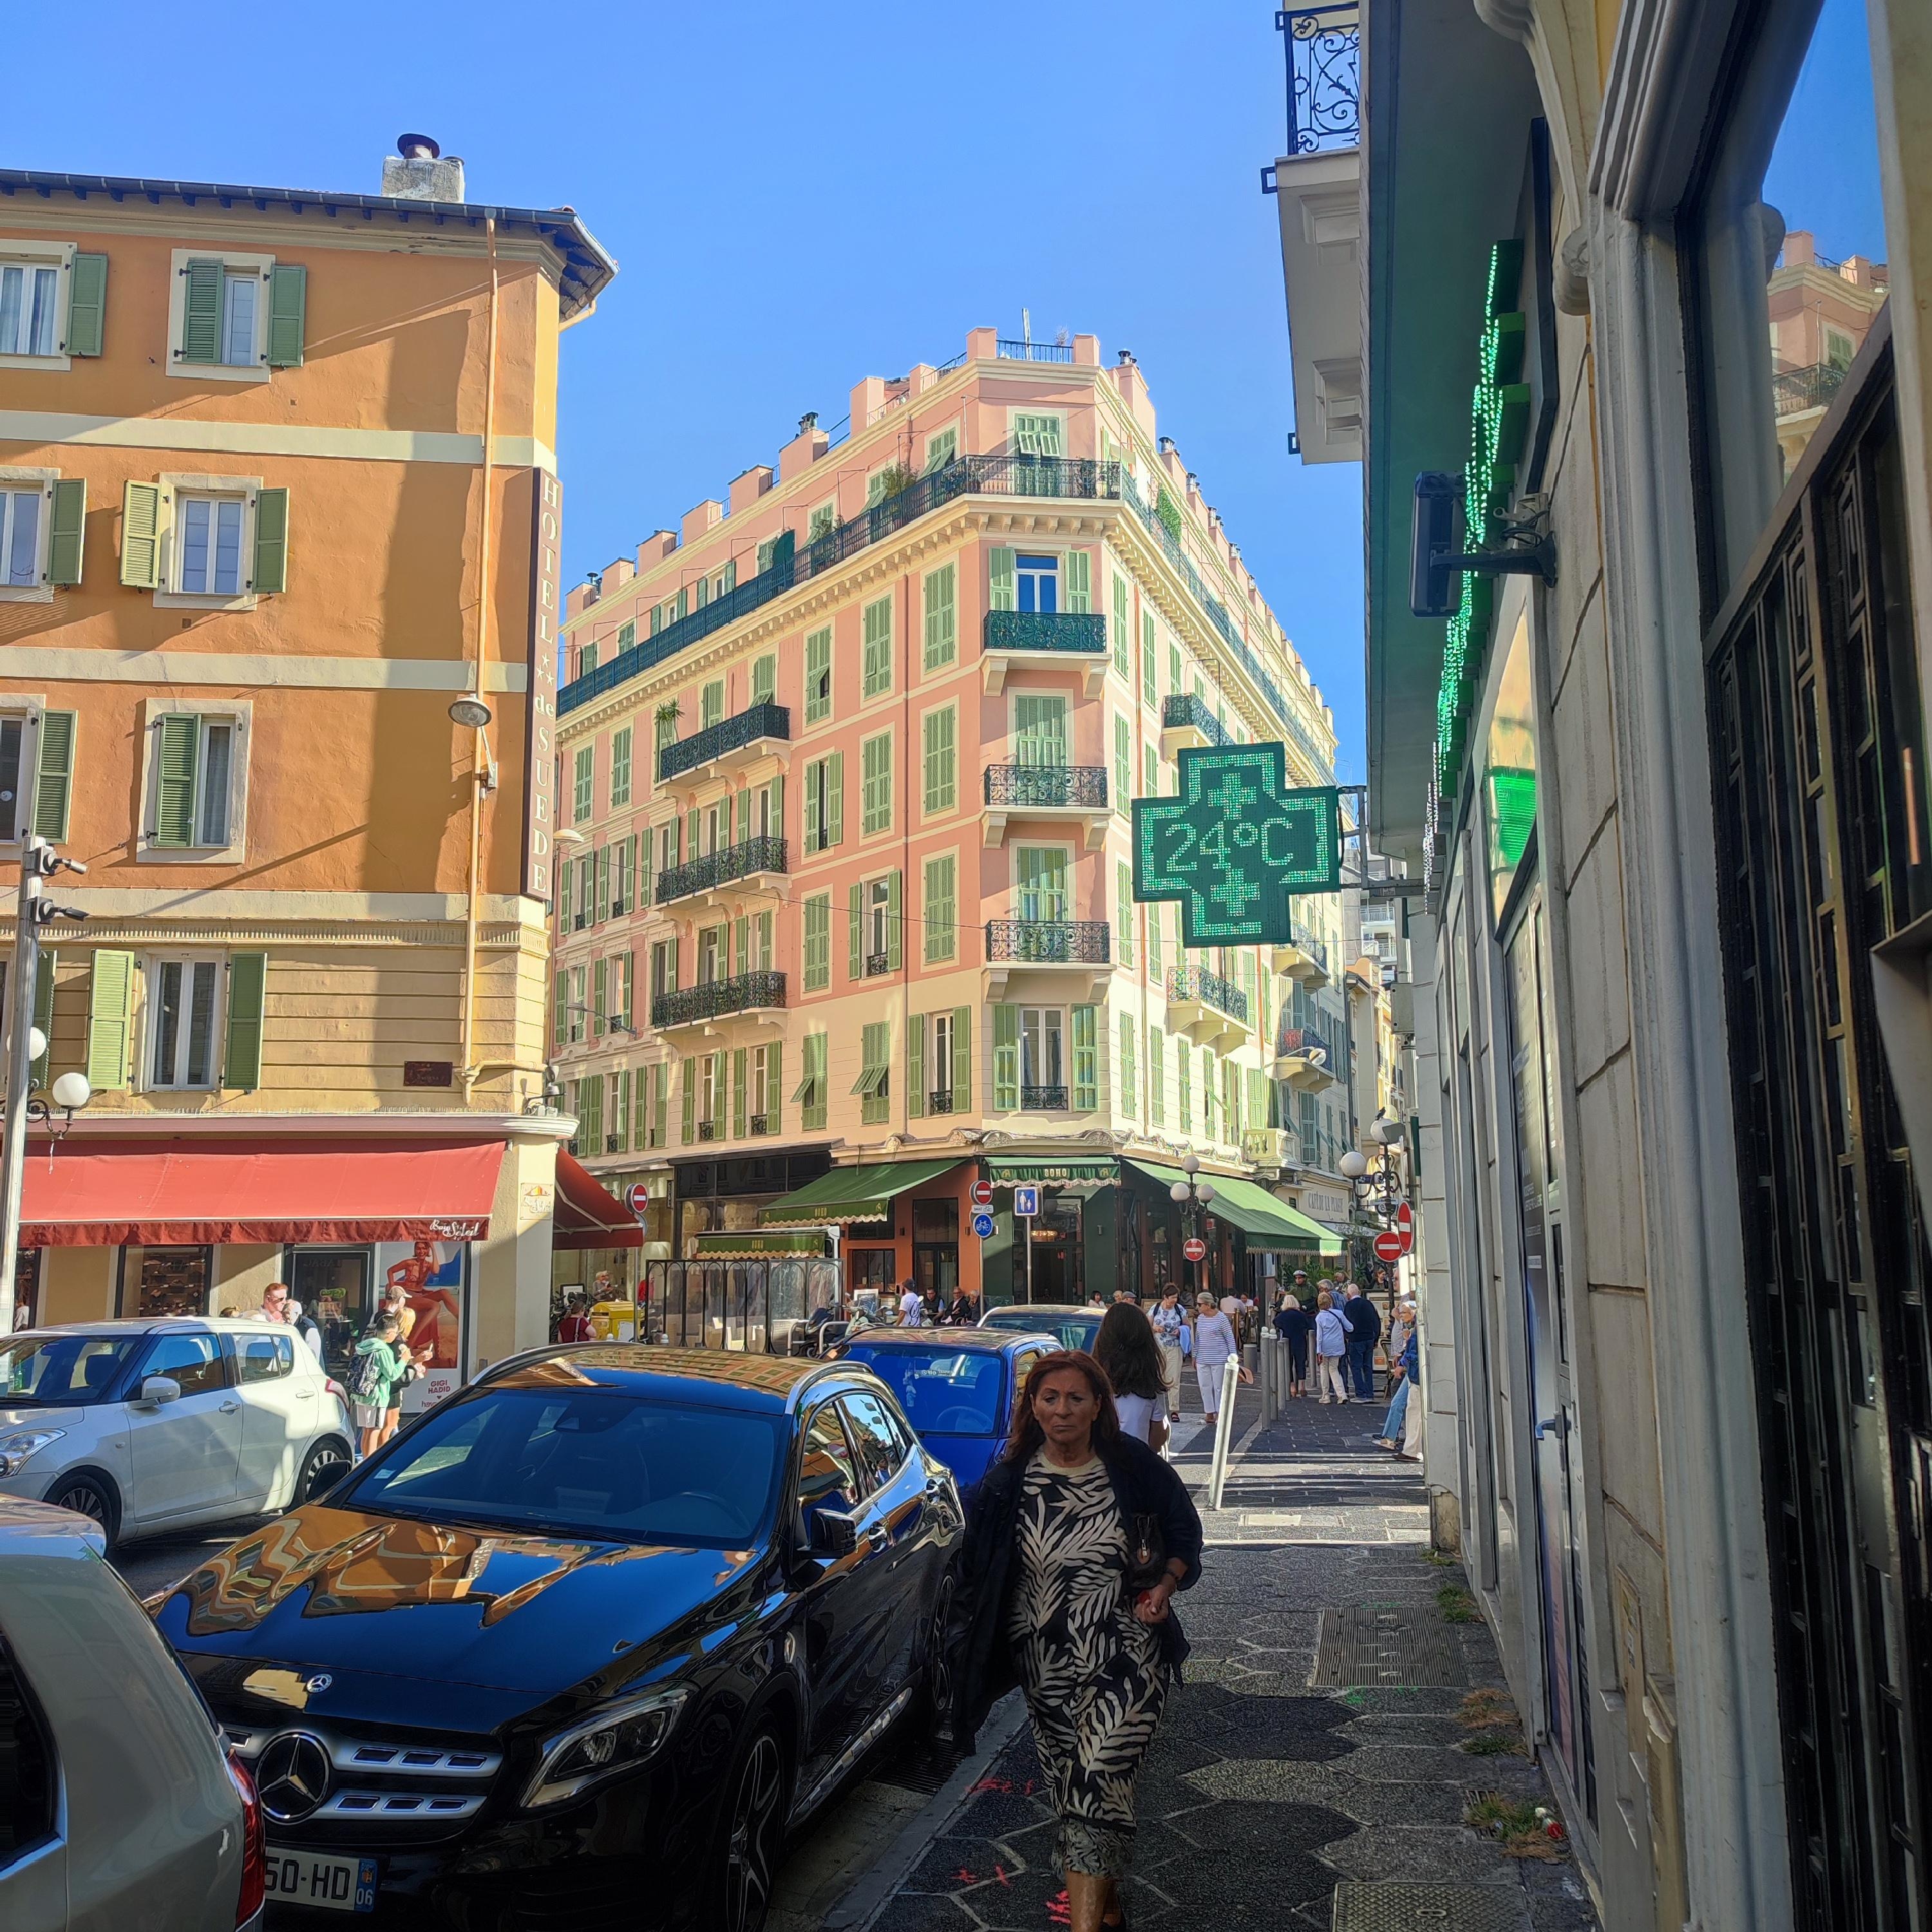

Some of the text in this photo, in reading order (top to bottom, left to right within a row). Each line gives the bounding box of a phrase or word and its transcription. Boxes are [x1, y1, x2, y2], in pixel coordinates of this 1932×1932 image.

[532, 473, 558, 893] HOTEL de SUEDE
[355, 1888, 374, 1906] 06
